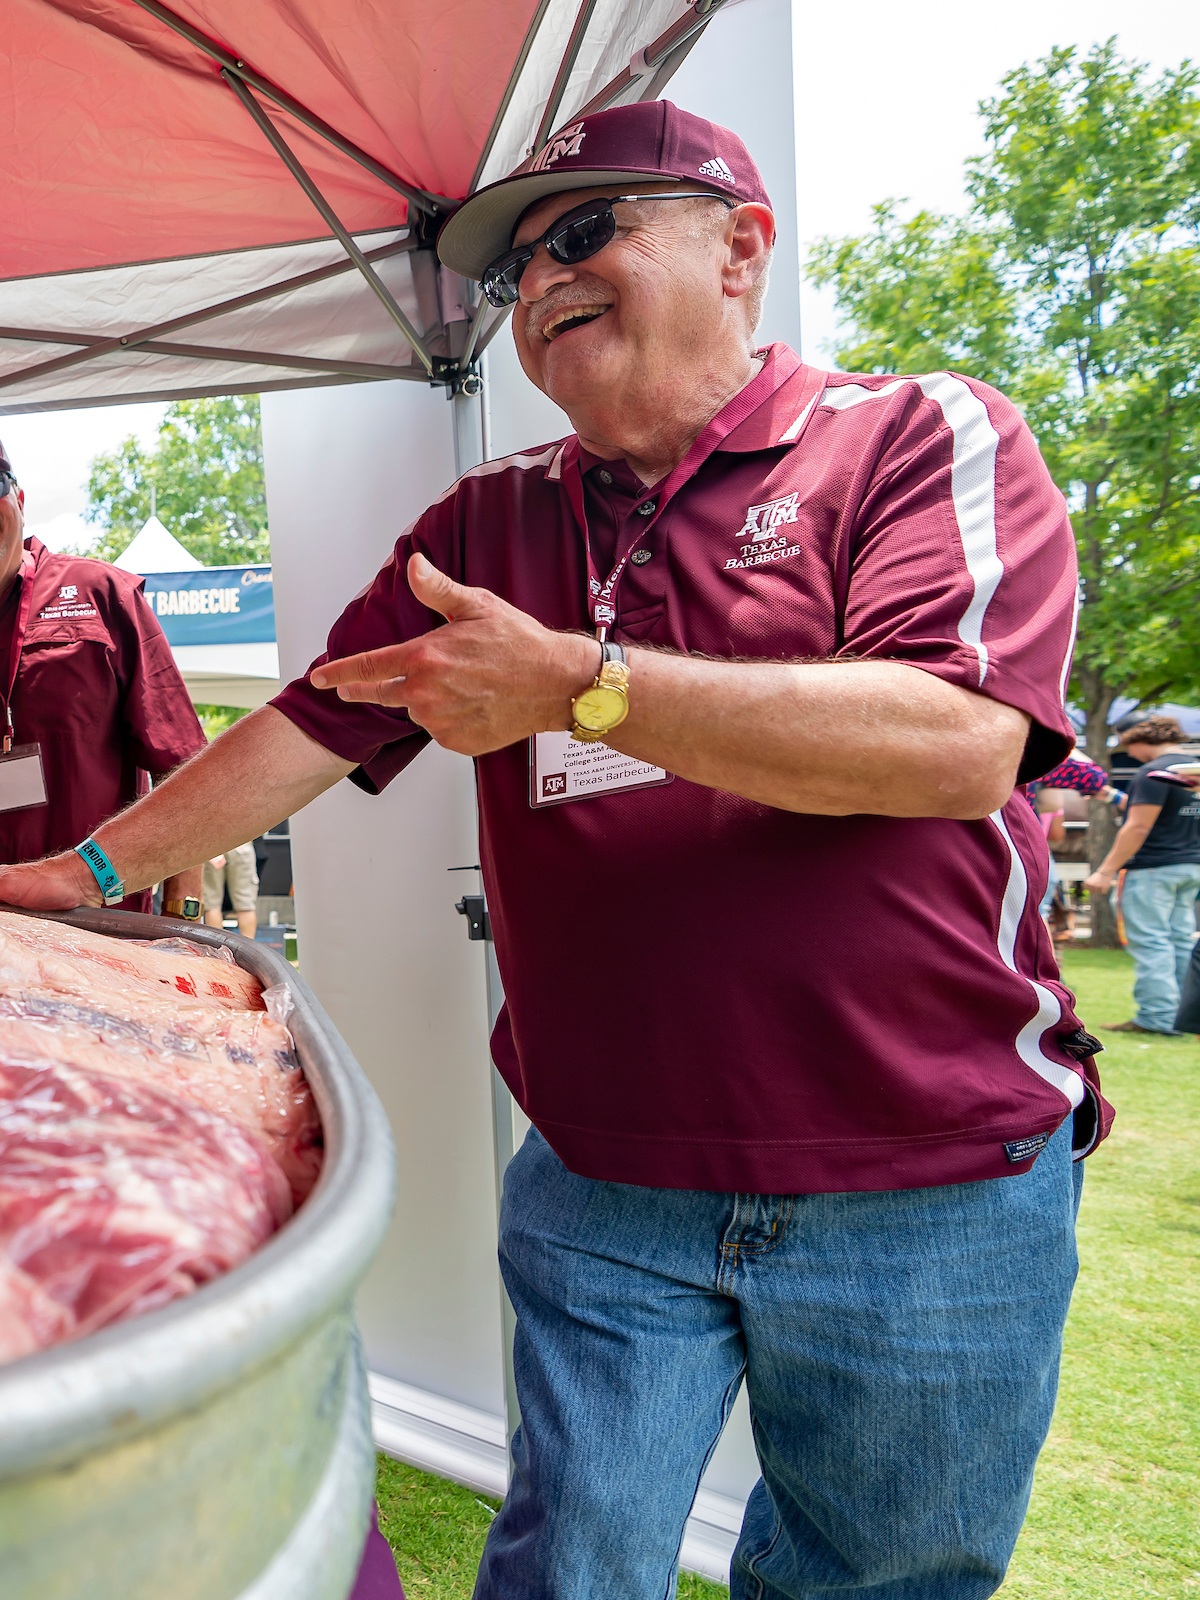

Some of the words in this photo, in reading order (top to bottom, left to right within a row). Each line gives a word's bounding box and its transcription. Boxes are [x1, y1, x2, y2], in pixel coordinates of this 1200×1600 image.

[698, 165, 736, 185] adidas
[723, 545, 801, 570] BARBECUE
[740, 537, 787, 558] TEXAS
[157, 587, 241, 616] BARBECUE
[40, 611, 61, 619] Texas
[62, 609, 97, 617] Barbecue
[562, 750, 584, 760] Texas
[585, 746, 605, 756] A&M
[564, 758, 591, 768] College
[593, 752, 622, 763] Station,
[606, 760, 640, 771] UNIVERSITY
[573, 776, 603, 787] Texas
[606, 765, 657, 781] Barbecue
